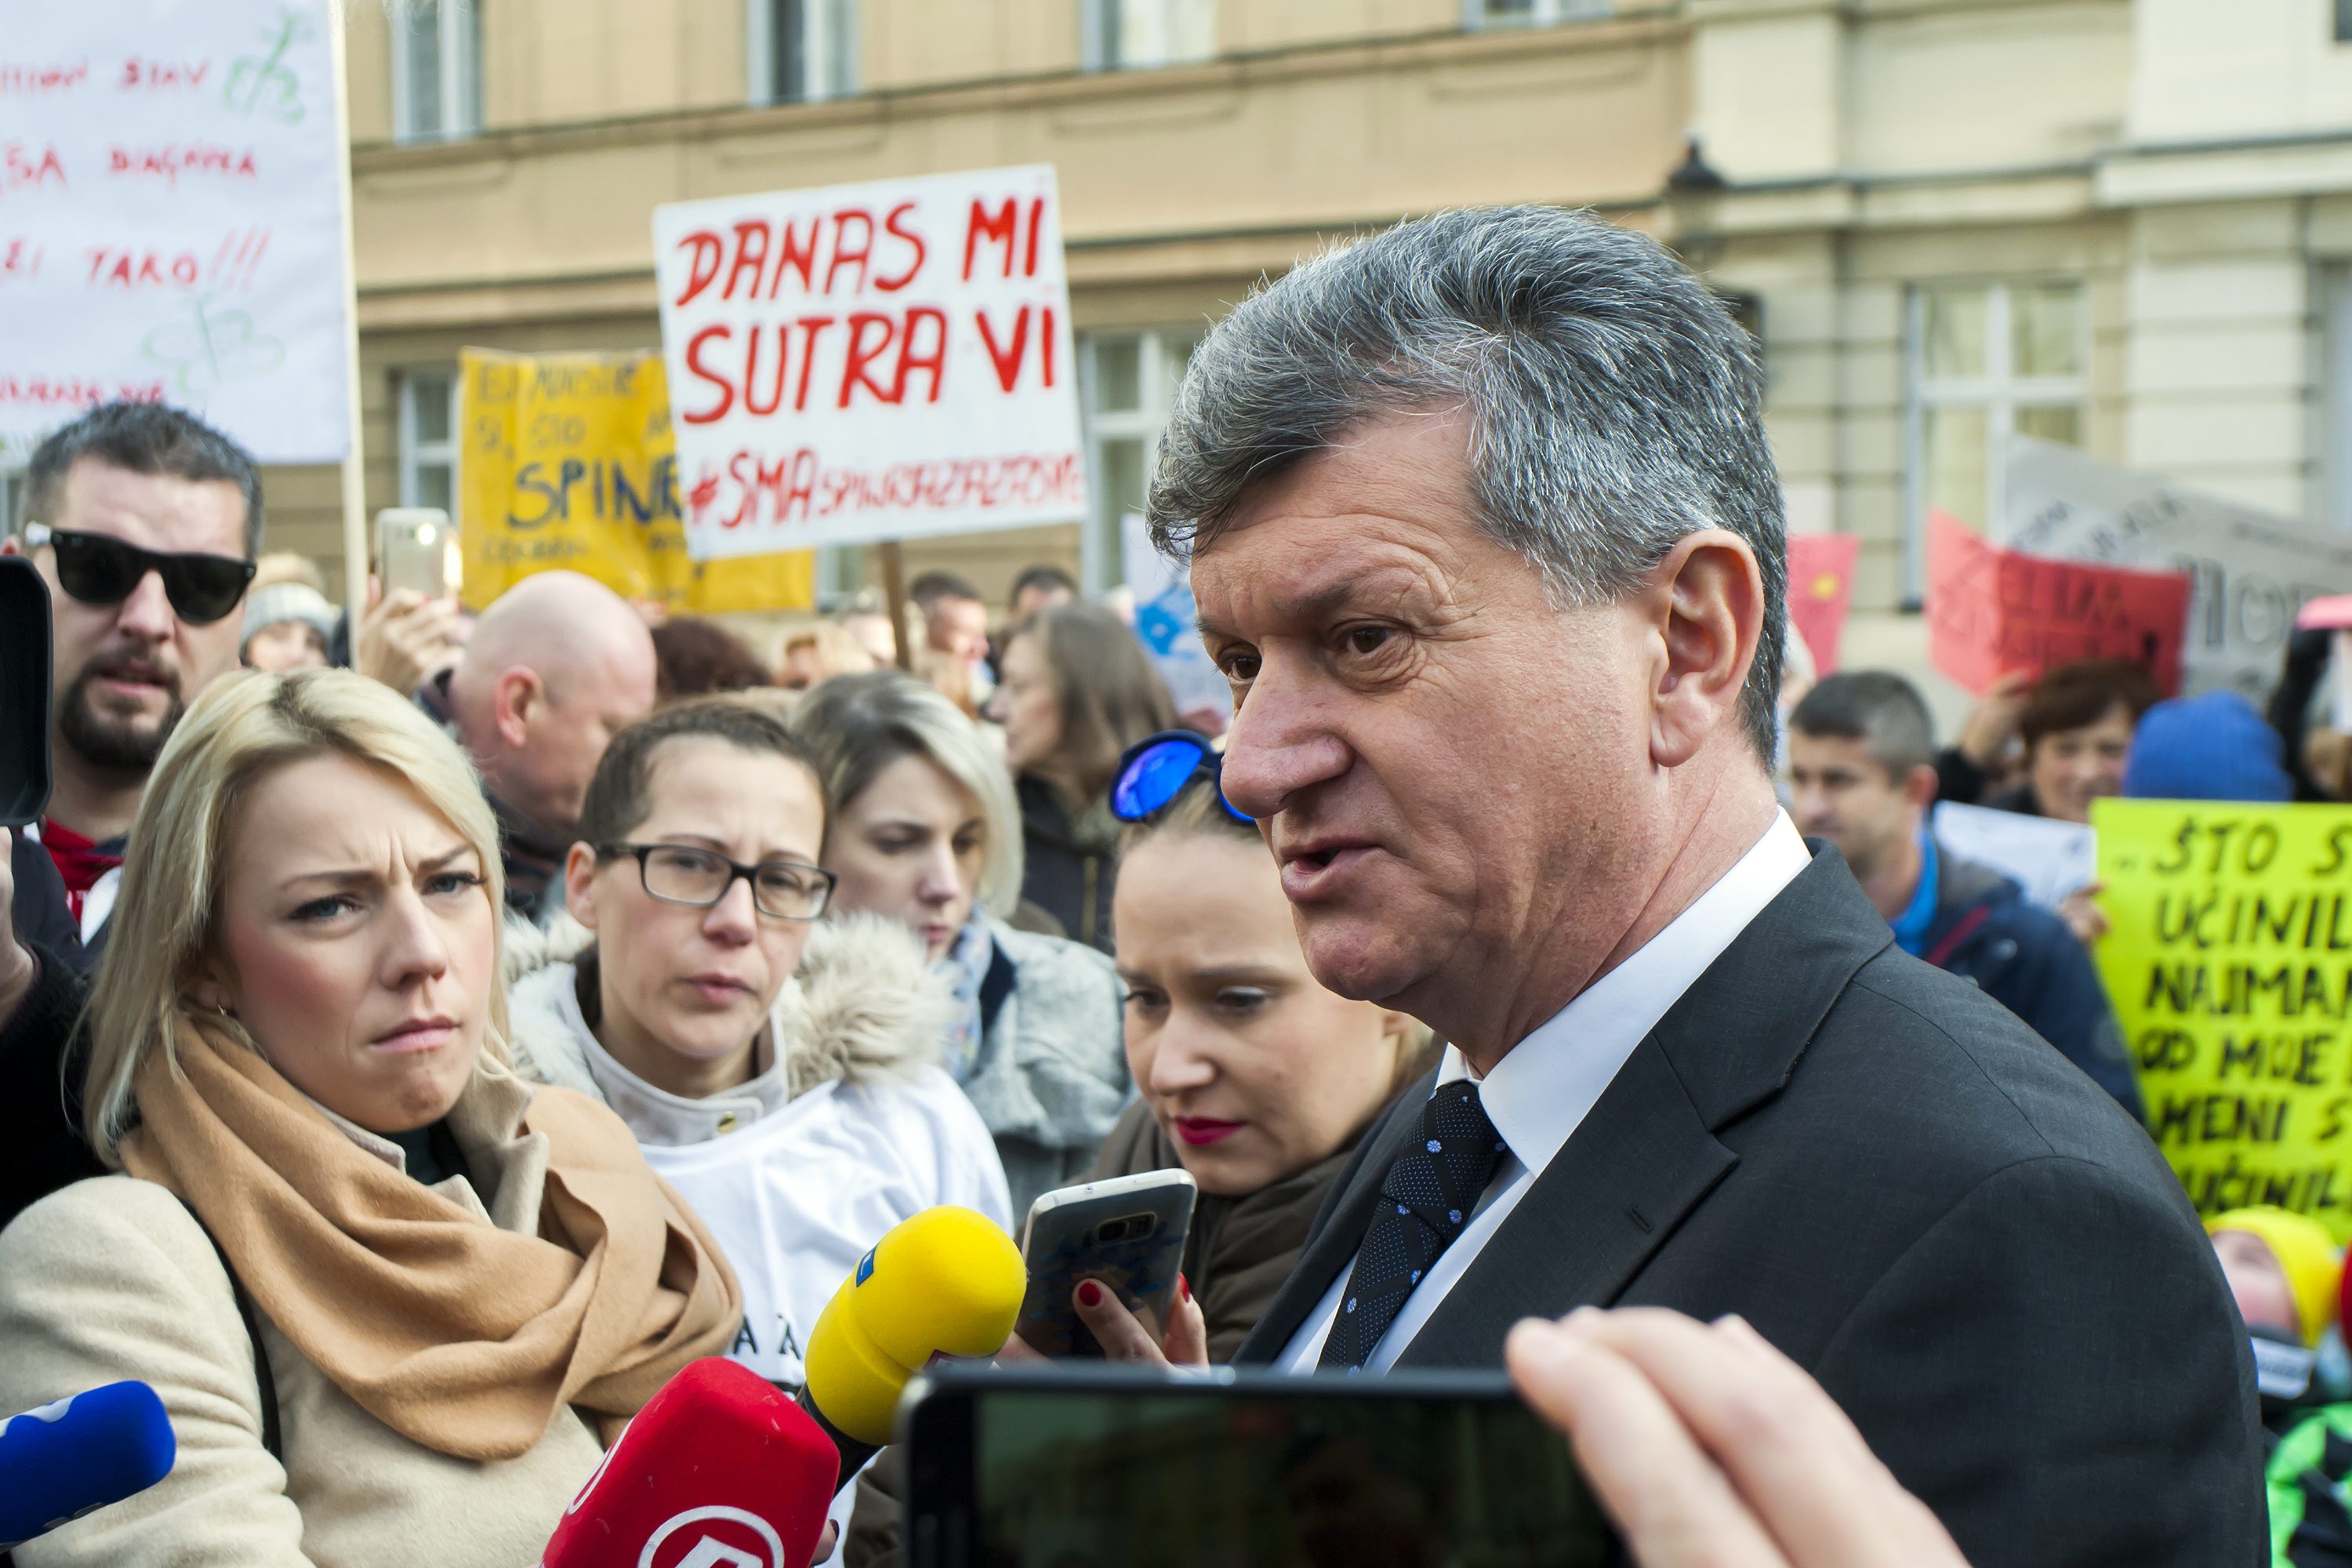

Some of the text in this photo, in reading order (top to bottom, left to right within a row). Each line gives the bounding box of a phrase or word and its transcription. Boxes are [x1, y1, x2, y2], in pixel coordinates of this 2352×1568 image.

[676, 194, 1044, 307] DANAS MI
[684, 304, 1054, 424] SUTRA VI
